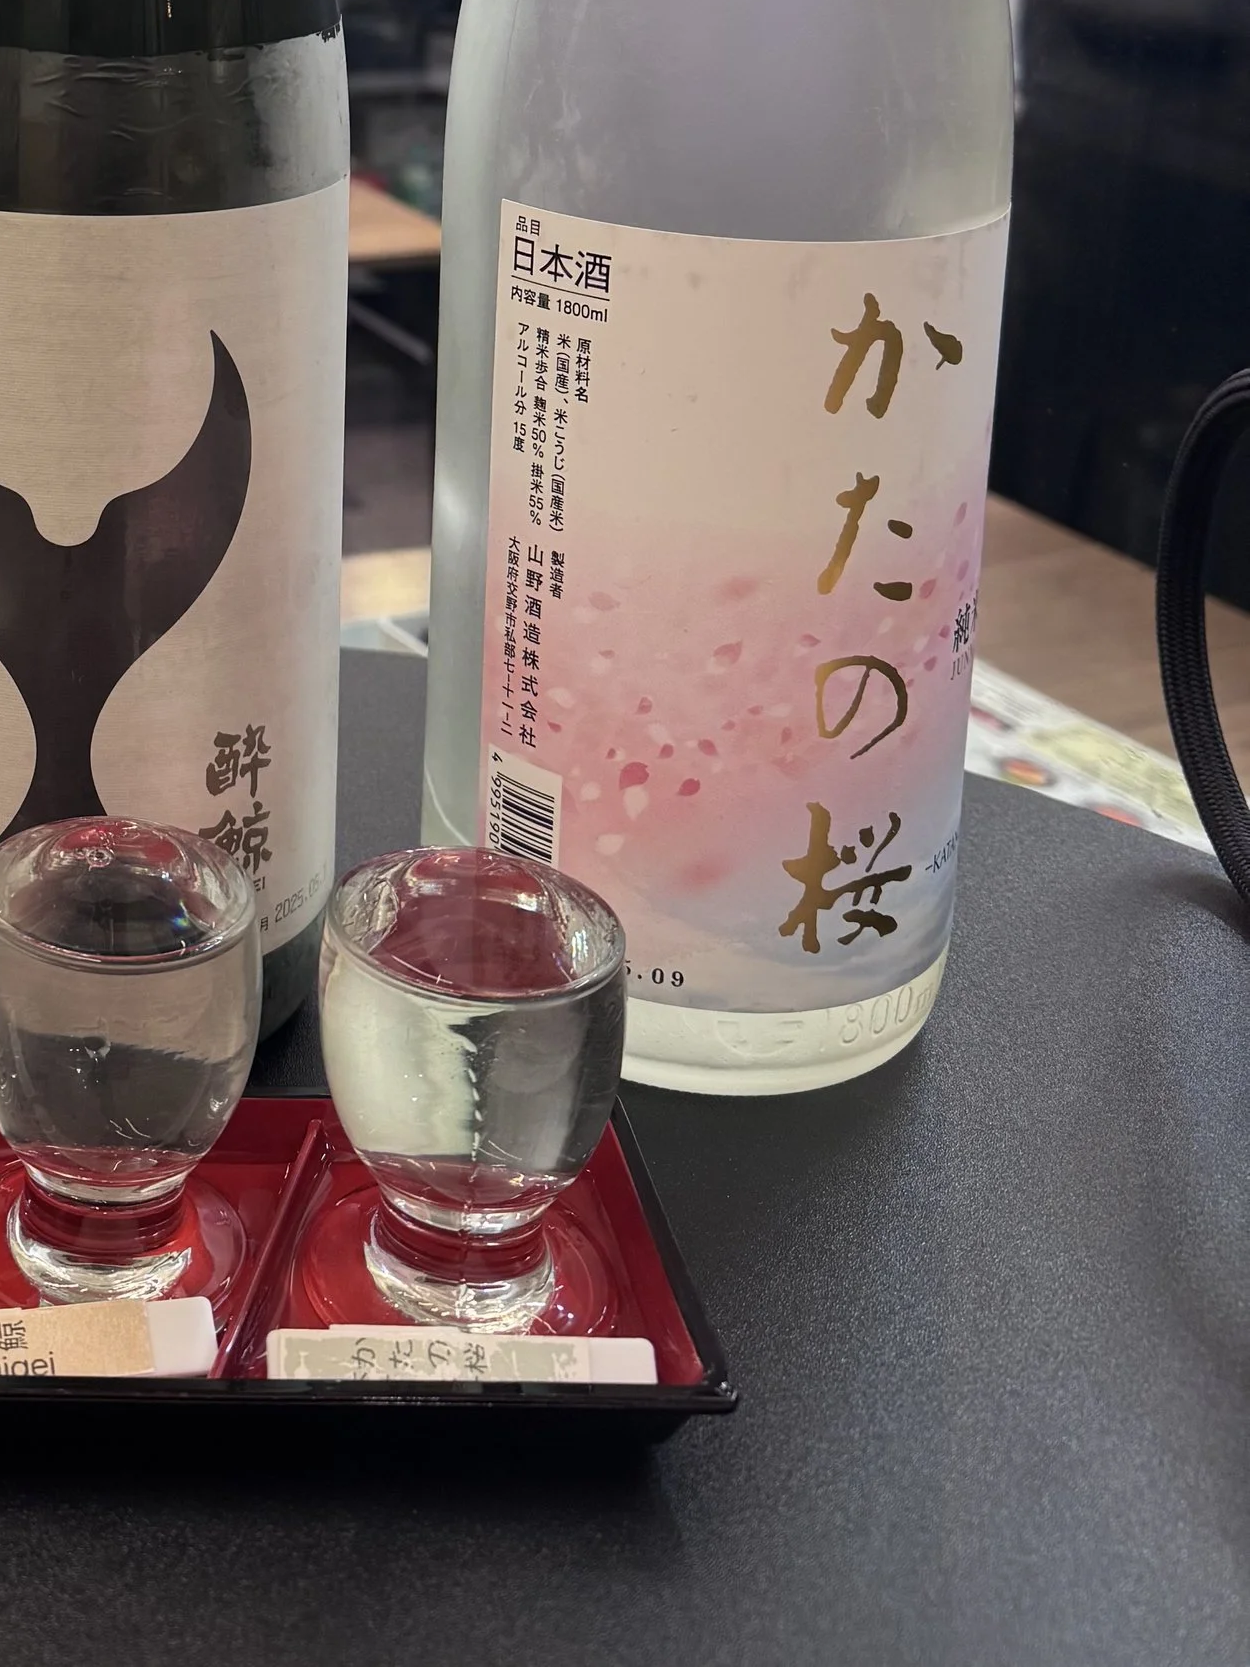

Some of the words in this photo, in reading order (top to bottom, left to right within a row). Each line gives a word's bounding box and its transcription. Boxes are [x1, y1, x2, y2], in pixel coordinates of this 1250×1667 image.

[516, 215, 540, 236] 品目
[513, 235, 612, 294] 日本酒
[510, 285, 551, 310] 内容量
[556, 299, 608, 323] 1800ml
[513, 322, 530, 416] アルコール分
[533, 326, 550, 392] 精米歩合
[574, 337, 592, 404] 原材料名
[512, 421, 527, 453] 15度
[549, 550, 565, 600] 製造者
[519, 543, 545, 749] 山野酒造株式会社
[779, 292, 963, 954] かたの桜
[492, 752, 503, 763] 4
[199, 723, 273, 876] 酔鯨
